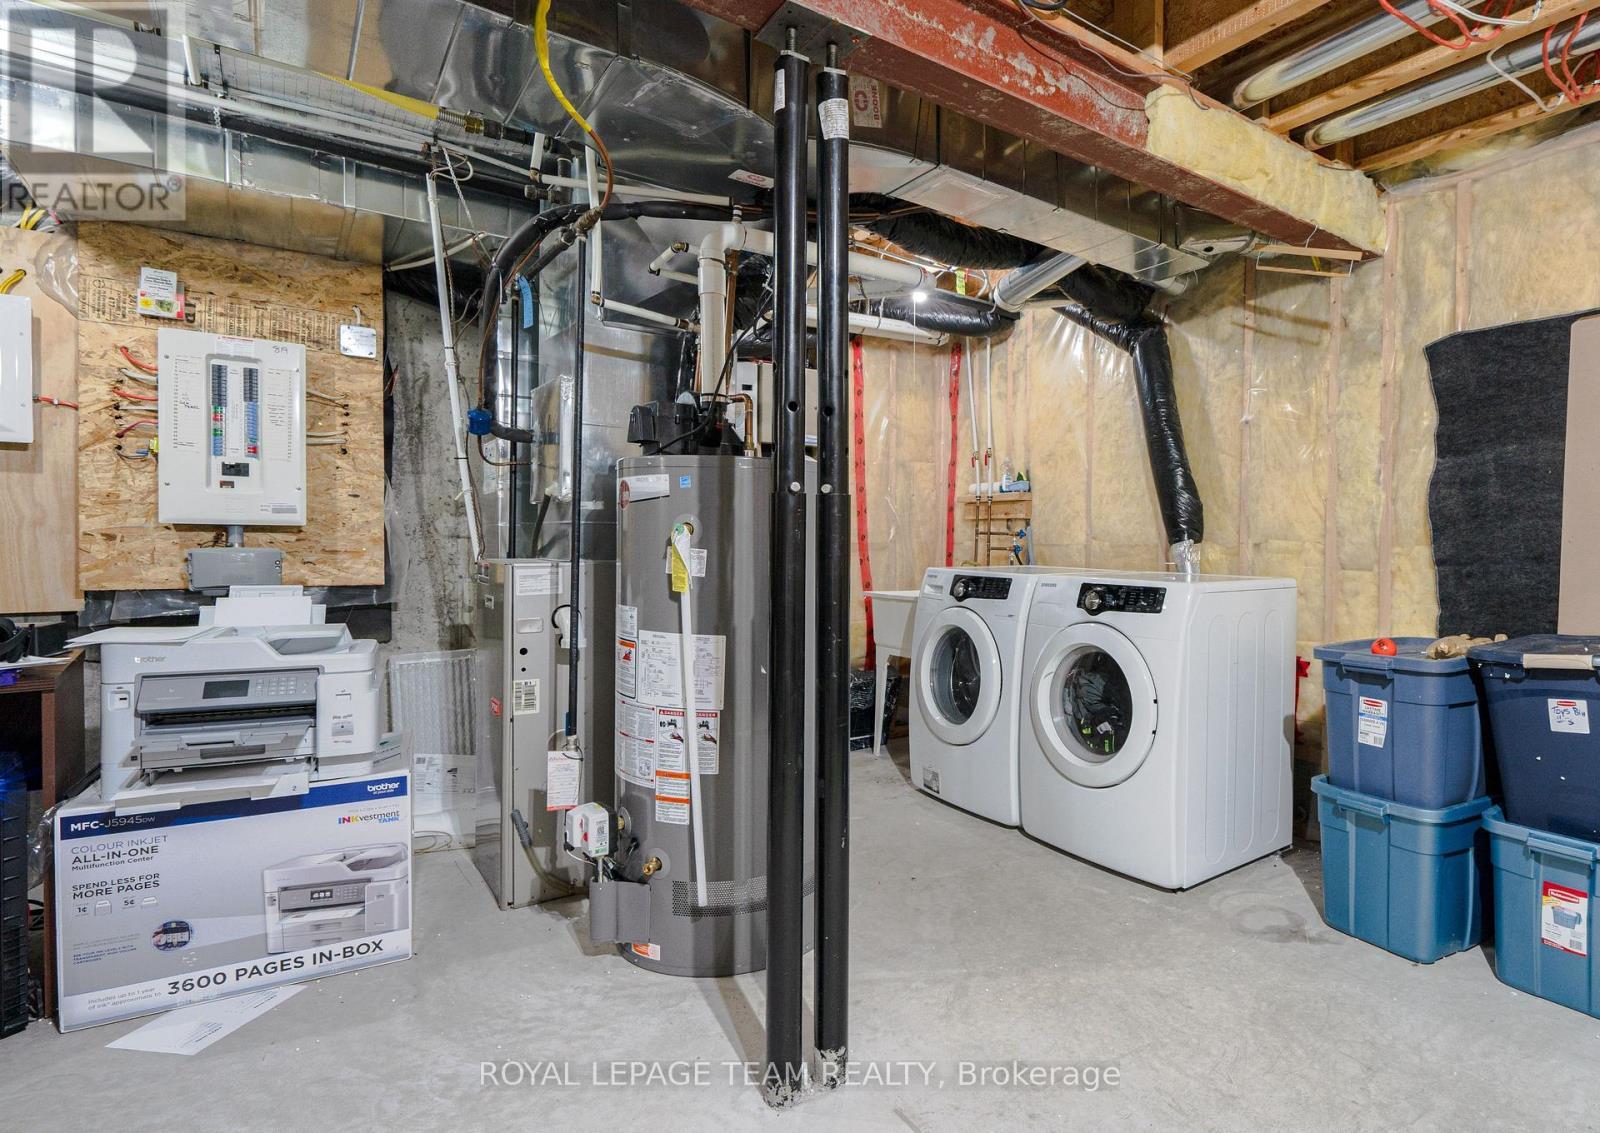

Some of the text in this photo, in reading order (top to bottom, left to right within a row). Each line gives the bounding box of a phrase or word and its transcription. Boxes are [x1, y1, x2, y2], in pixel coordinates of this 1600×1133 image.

[367, 782, 400, 792] brother
[338, 810, 400, 824] INKvestment
[71, 835, 168, 855] COLOUR INKJET
[72, 845, 160, 865] ALL-IN-ONE
[72, 855, 154, 872] Multifunction Center
[72, 873, 160, 892] SPEND LESS FOR
[73, 880, 160, 900] MORE PAGES
[167, 939, 384, 995] 3600 PAGES IN-BOX
[88, 993, 116, 1005] Includes
